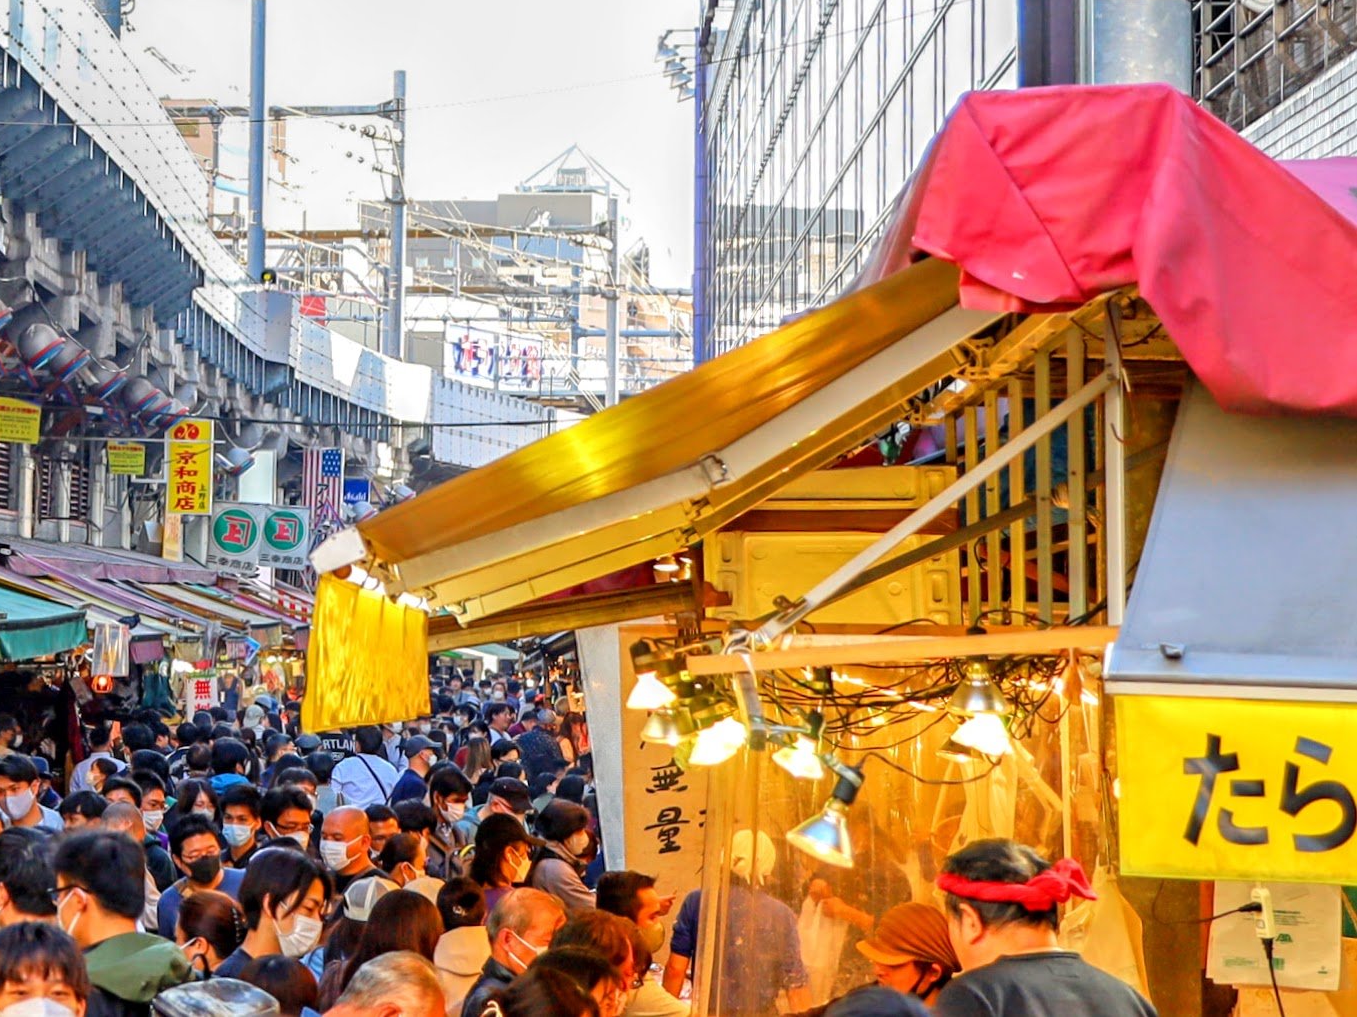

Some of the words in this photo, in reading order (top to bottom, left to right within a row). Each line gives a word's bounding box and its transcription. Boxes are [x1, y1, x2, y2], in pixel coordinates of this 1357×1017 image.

[174, 450, 199, 511] 京和商店
[198, 482, 206, 510] 上野店
[1183, 732, 1357, 853] たら
